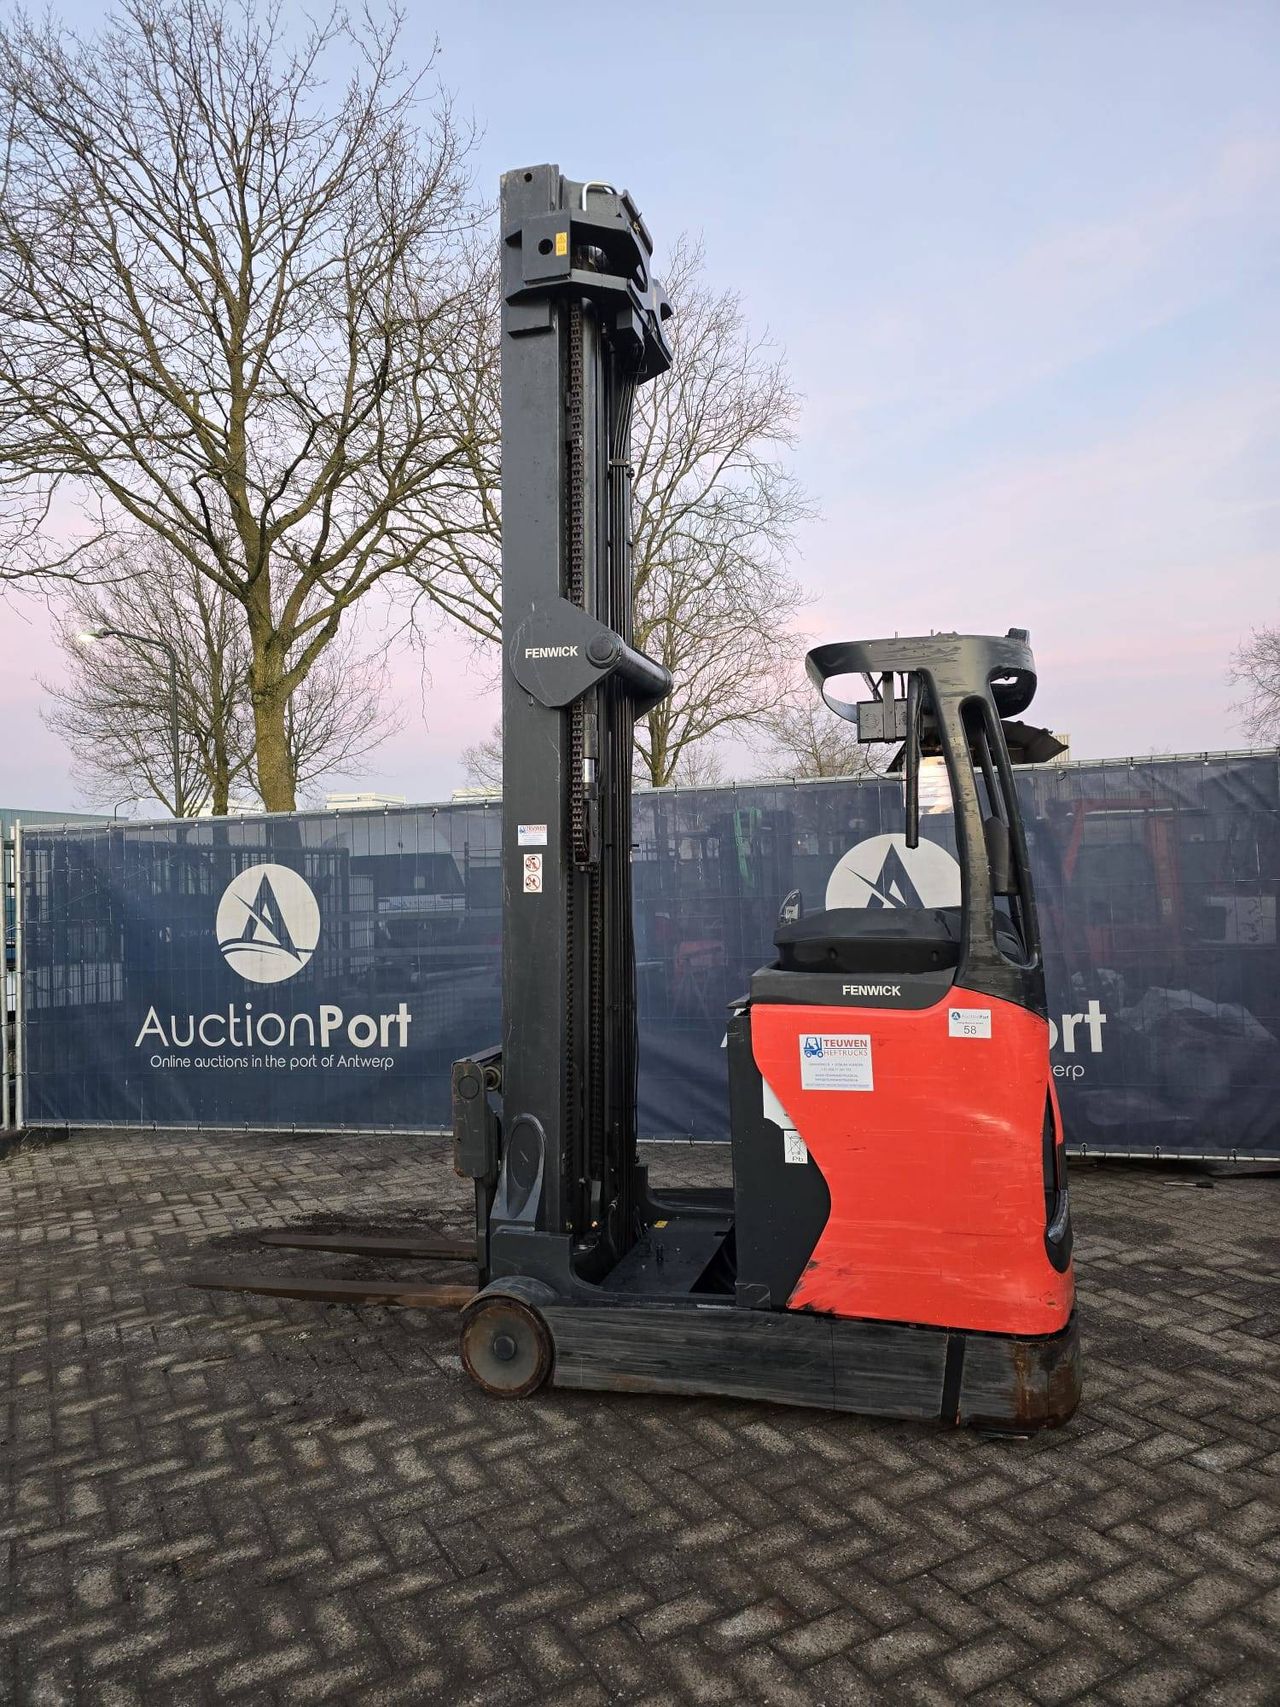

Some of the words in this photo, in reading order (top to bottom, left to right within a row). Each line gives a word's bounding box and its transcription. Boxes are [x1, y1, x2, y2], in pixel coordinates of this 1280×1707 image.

[525, 645, 579, 659] FENWICK
[842, 984, 901, 997] FENWICK
[134, 1002, 412, 1049] AuctionPort
[963, 1025, 977, 1035] 58
[823, 1039, 868, 1048] TEUWEN
[823, 1049, 868, 1057] HEFTRUCKS
[150, 1054, 191, 1068] Online
[194, 1054, 249, 1068] auctions
[251, 1054, 262, 1068] in
[265, 1054, 286, 1068] the
[290, 1054, 317, 1071] port
[320, 1054, 334, 1068] of
[336, 1054, 394, 1071] Antwerp
